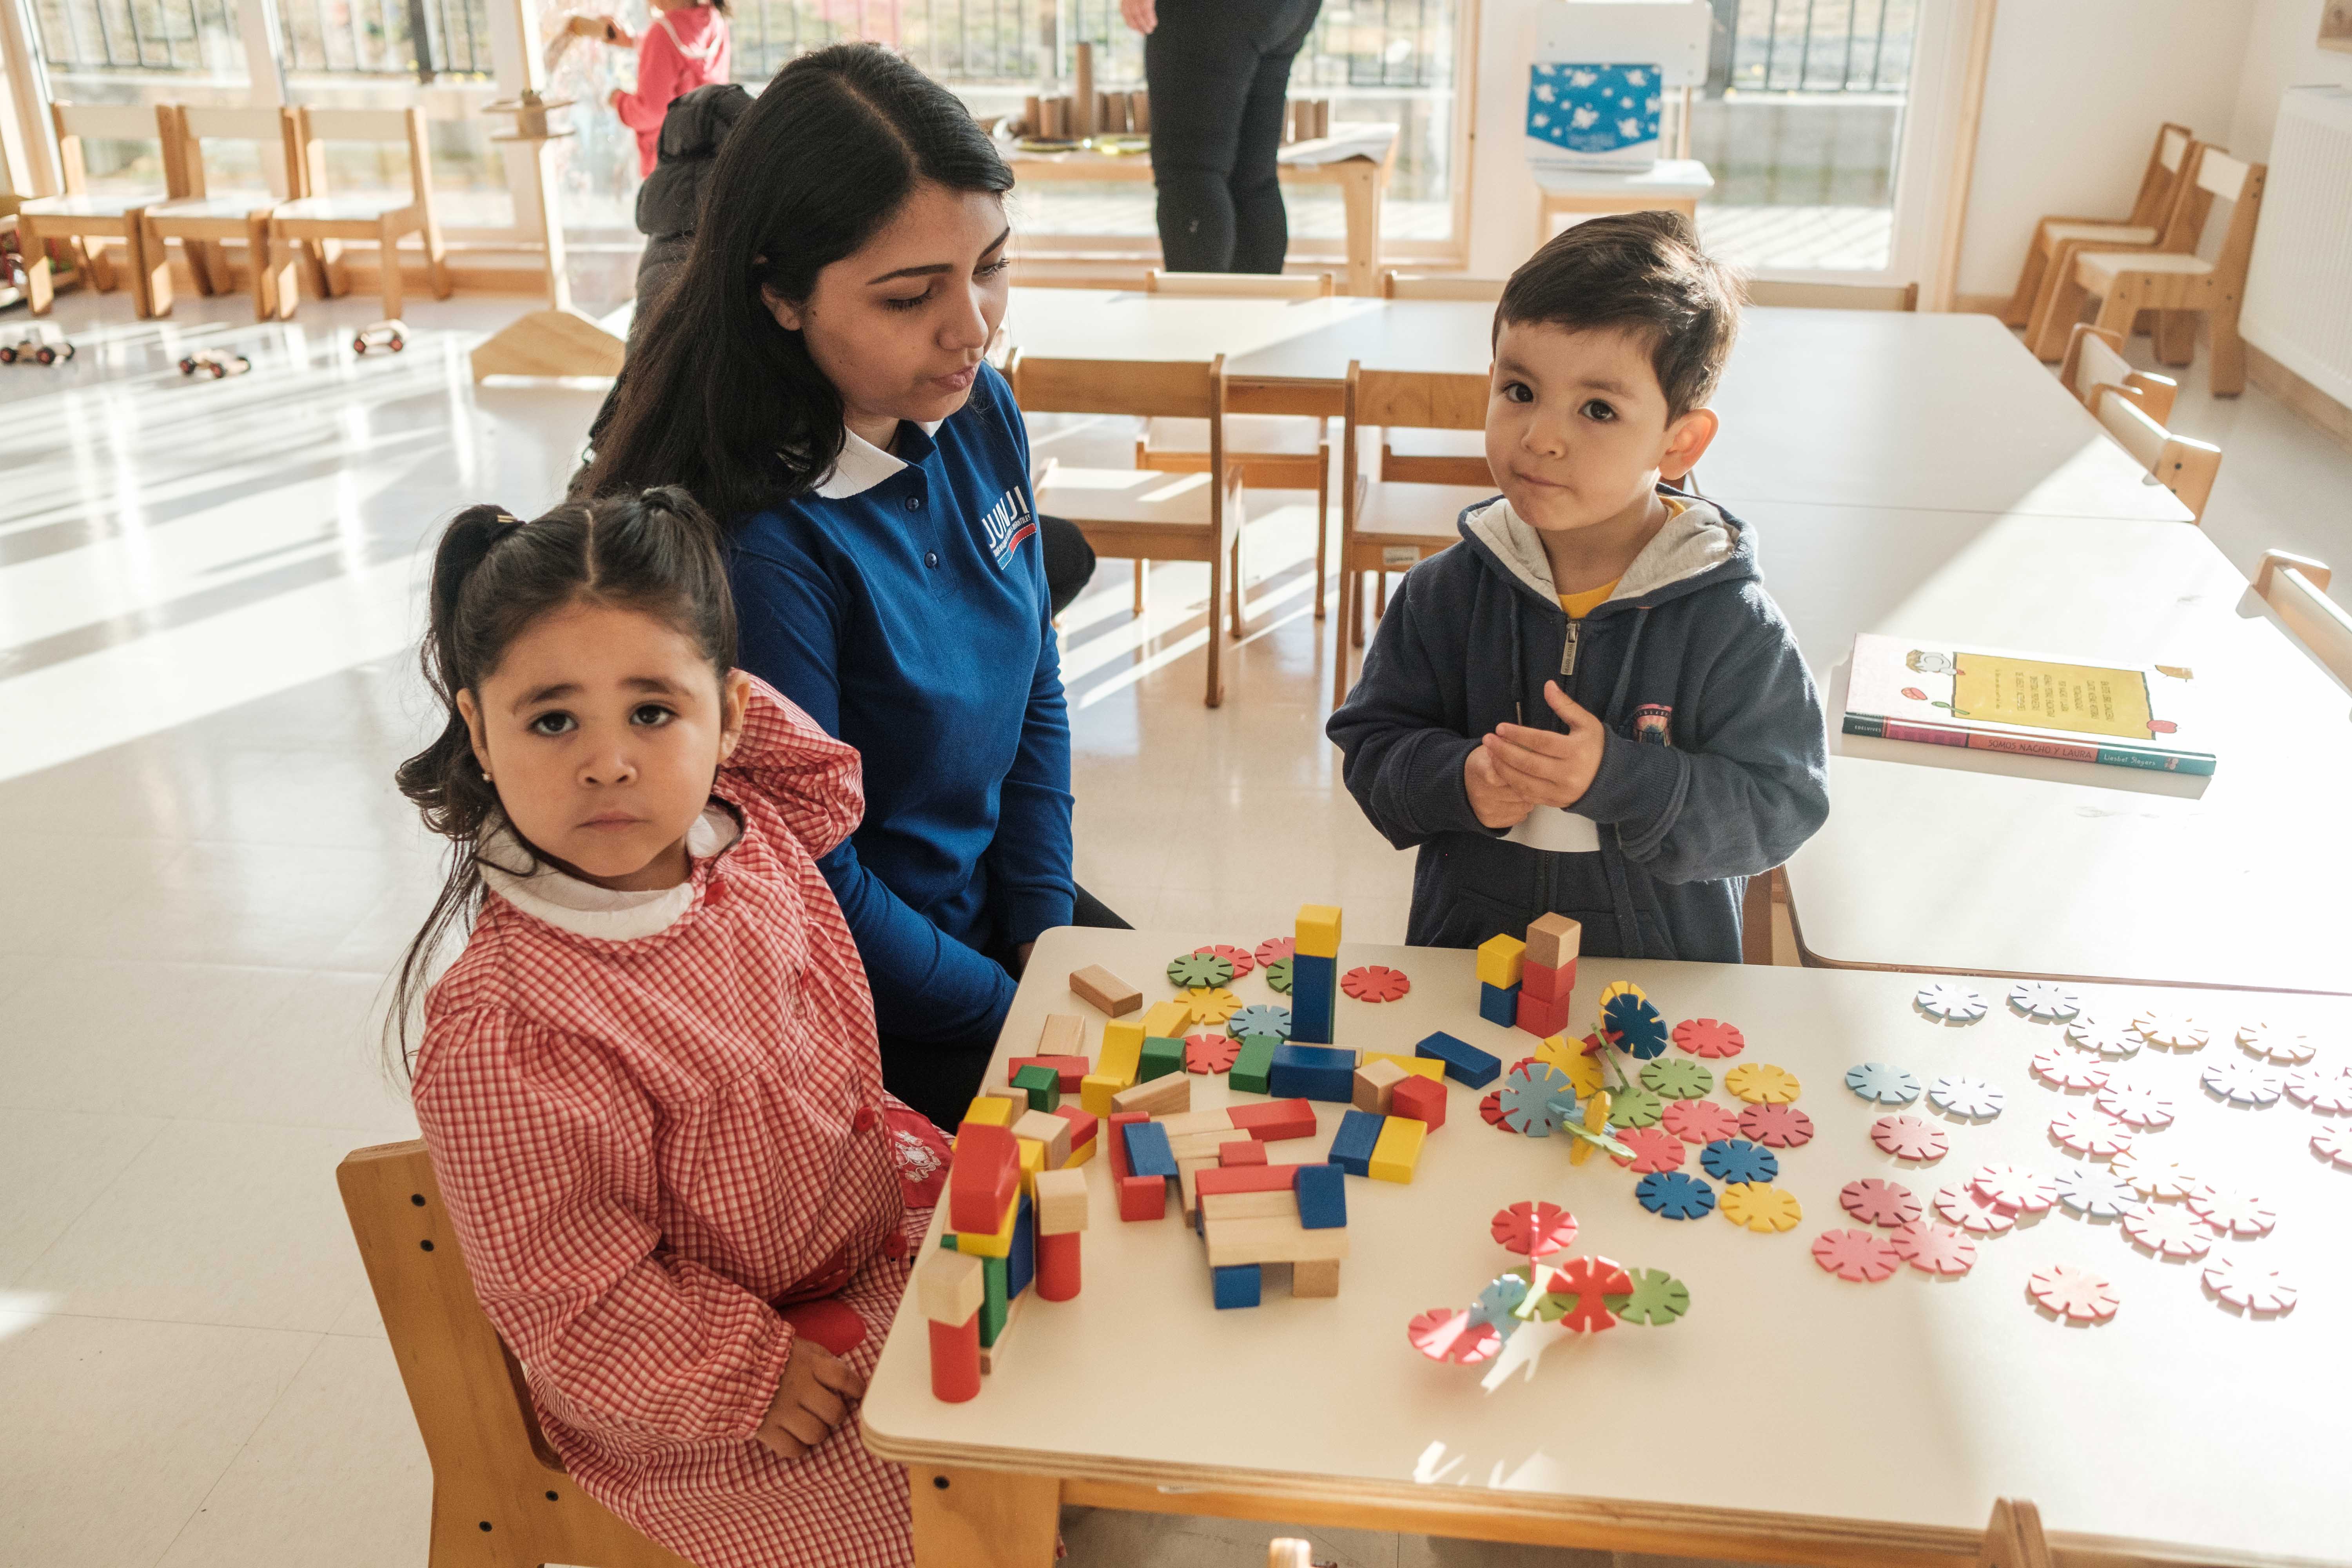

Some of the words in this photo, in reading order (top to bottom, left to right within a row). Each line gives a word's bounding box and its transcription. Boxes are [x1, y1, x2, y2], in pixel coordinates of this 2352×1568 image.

[982, 486, 1029, 549] JUNJI
[1988, 739, 2016, 750] SOMOS
[2019, 744, 2051, 754] NACHO
[2063, 748, 2092, 759] LAURA
[2104, 753, 2128, 762] Liesbet
[2131, 756, 2156, 766] Slegers
